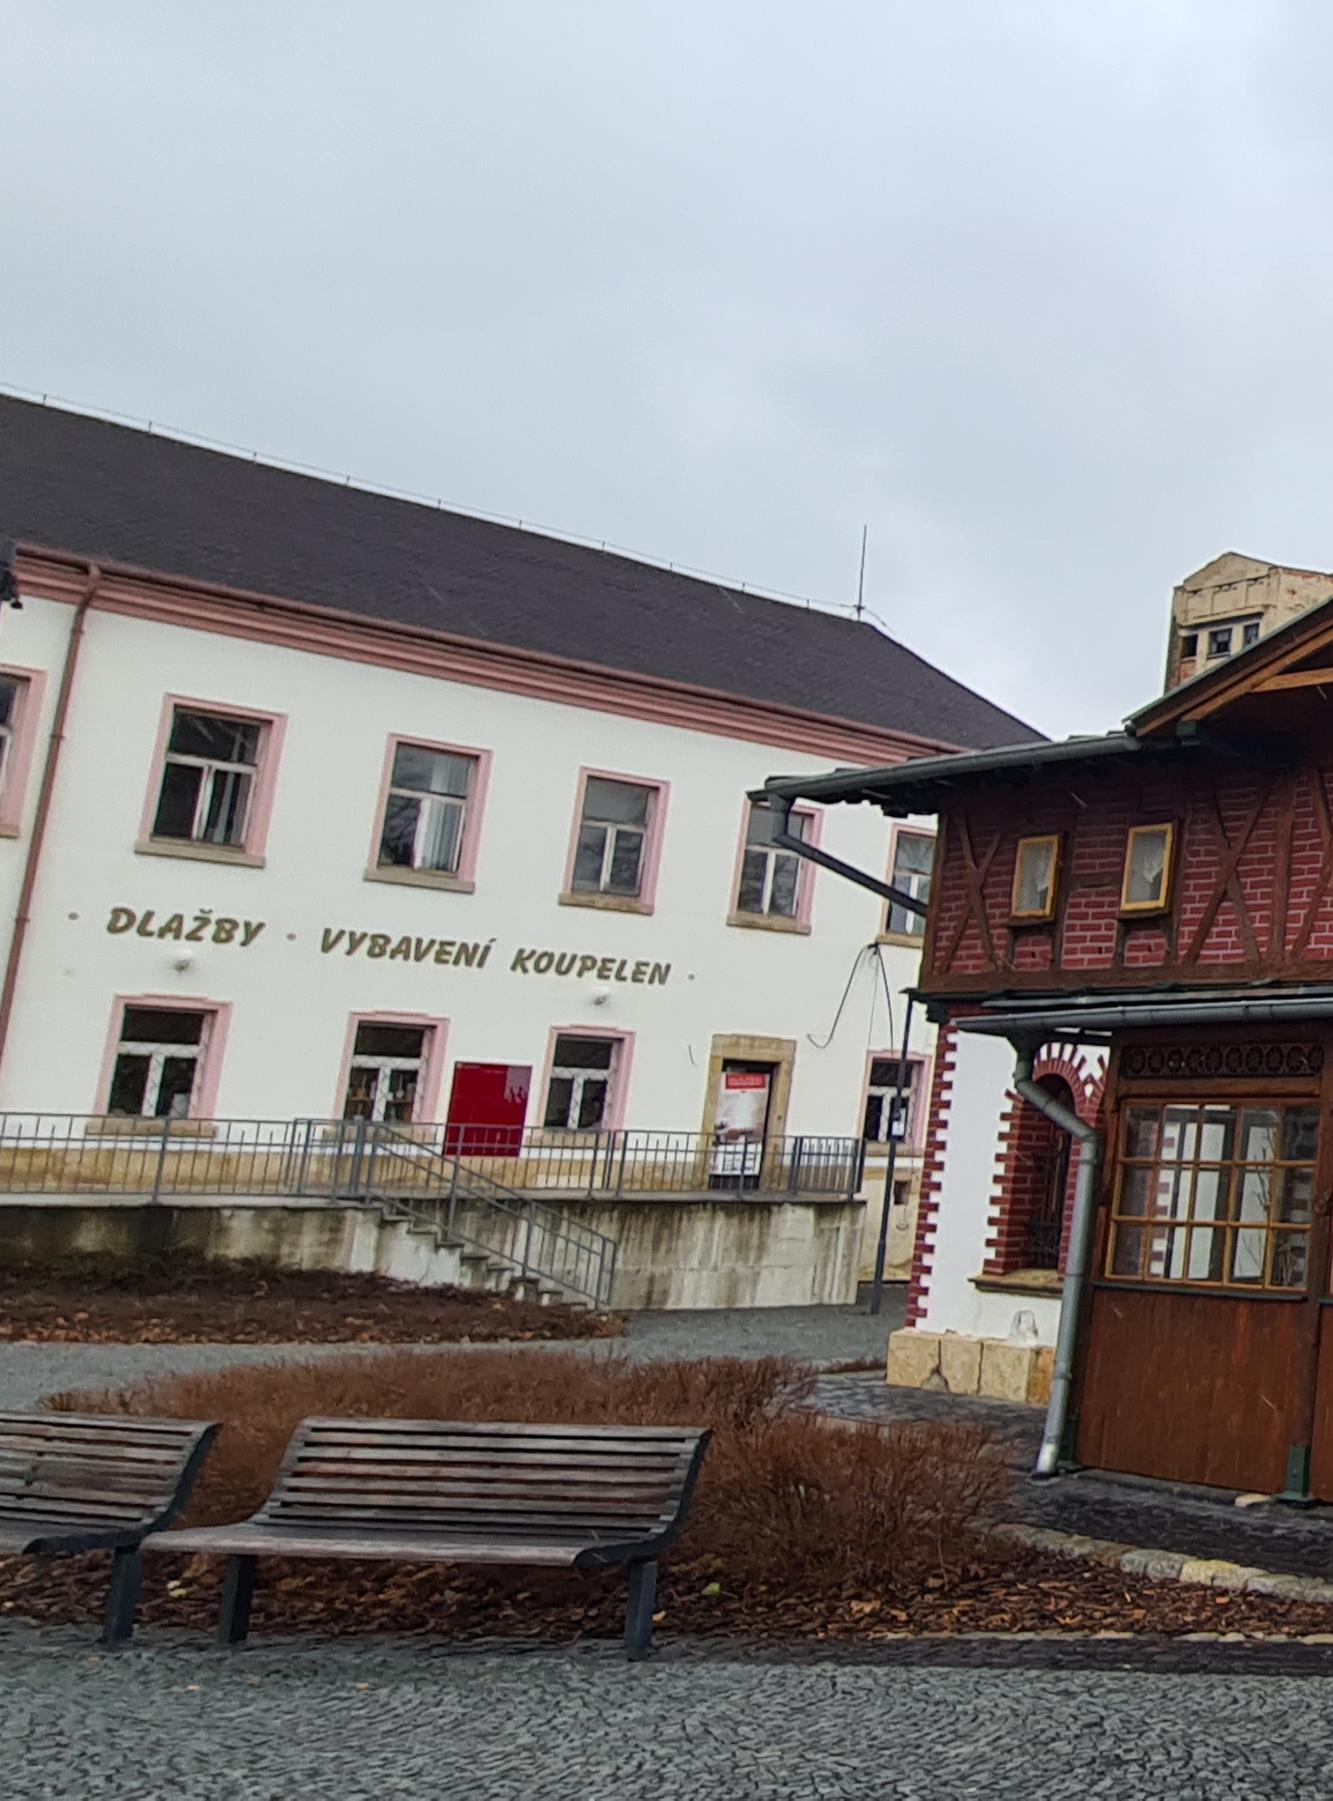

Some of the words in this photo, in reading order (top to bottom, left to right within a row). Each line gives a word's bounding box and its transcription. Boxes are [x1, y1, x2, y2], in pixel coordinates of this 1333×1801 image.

[107, 907, 266, 946] DLAŽBY
[320, 928, 497, 969] VYBAVENÍ
[510, 948, 671, 985] KOUPELEN
